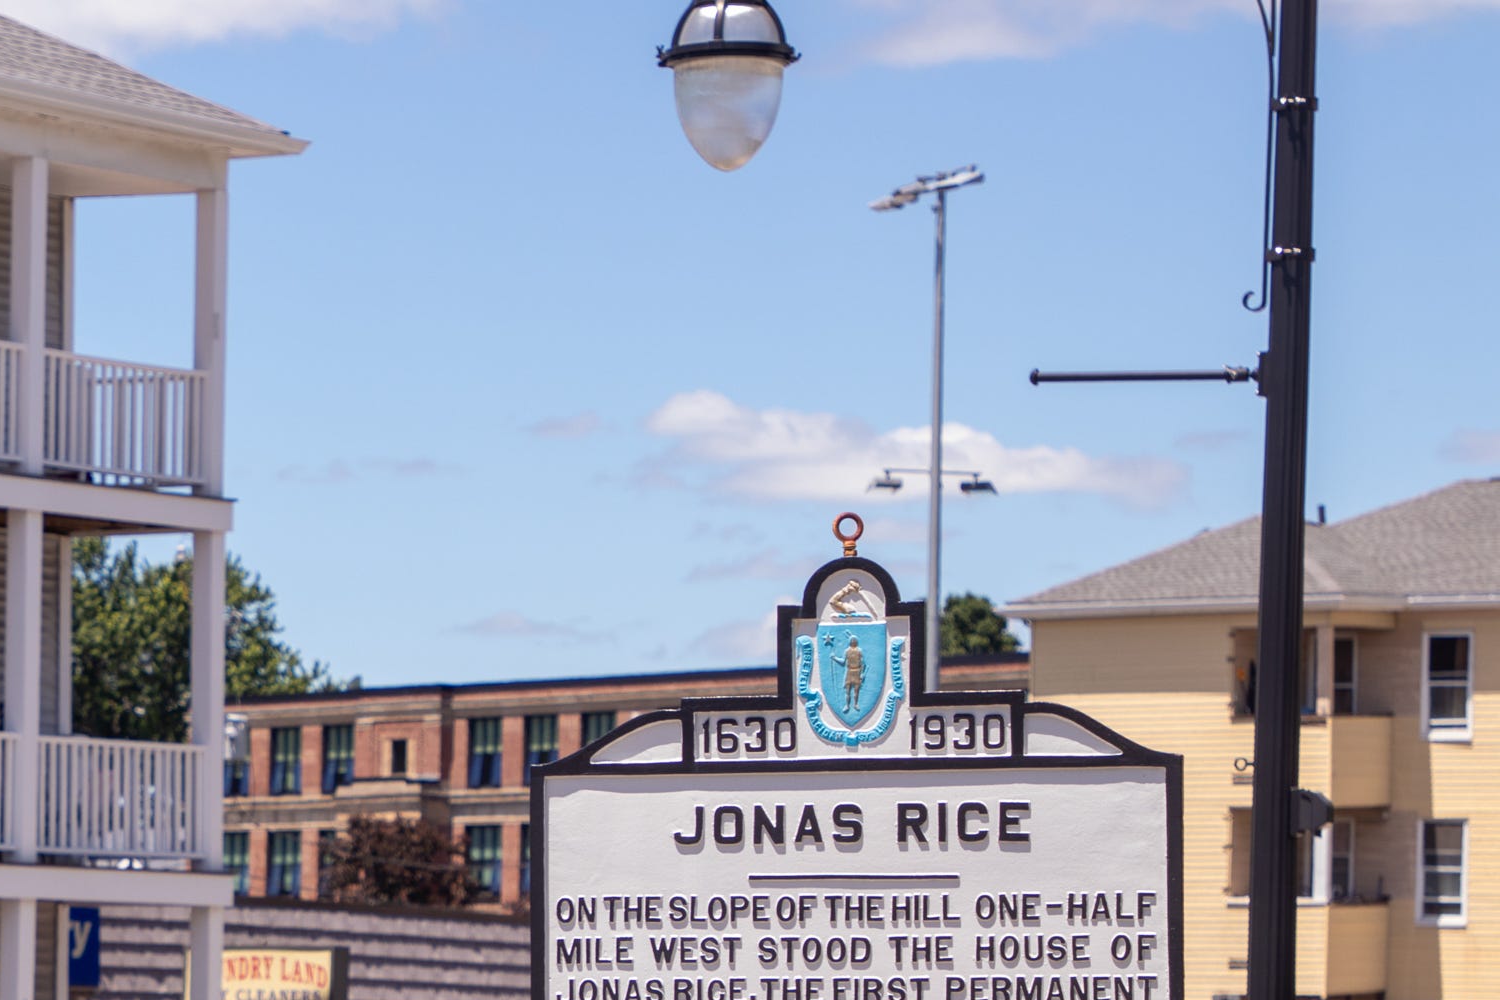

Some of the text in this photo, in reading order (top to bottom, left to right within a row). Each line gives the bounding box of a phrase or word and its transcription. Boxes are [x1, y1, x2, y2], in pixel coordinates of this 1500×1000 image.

[701, 716, 797, 754] 1630
[908, 712, 1006, 750] 1930
[674, 802, 1030, 845] JONAS RICE
[556, 892, 1156, 924] ON THE SLOPE OF THE HILL ONE-HALF
[556, 934, 1155, 964] MILE WEST STOOD THE HOUSE OF
[225, 955, 328, 988] NDRY LAND
